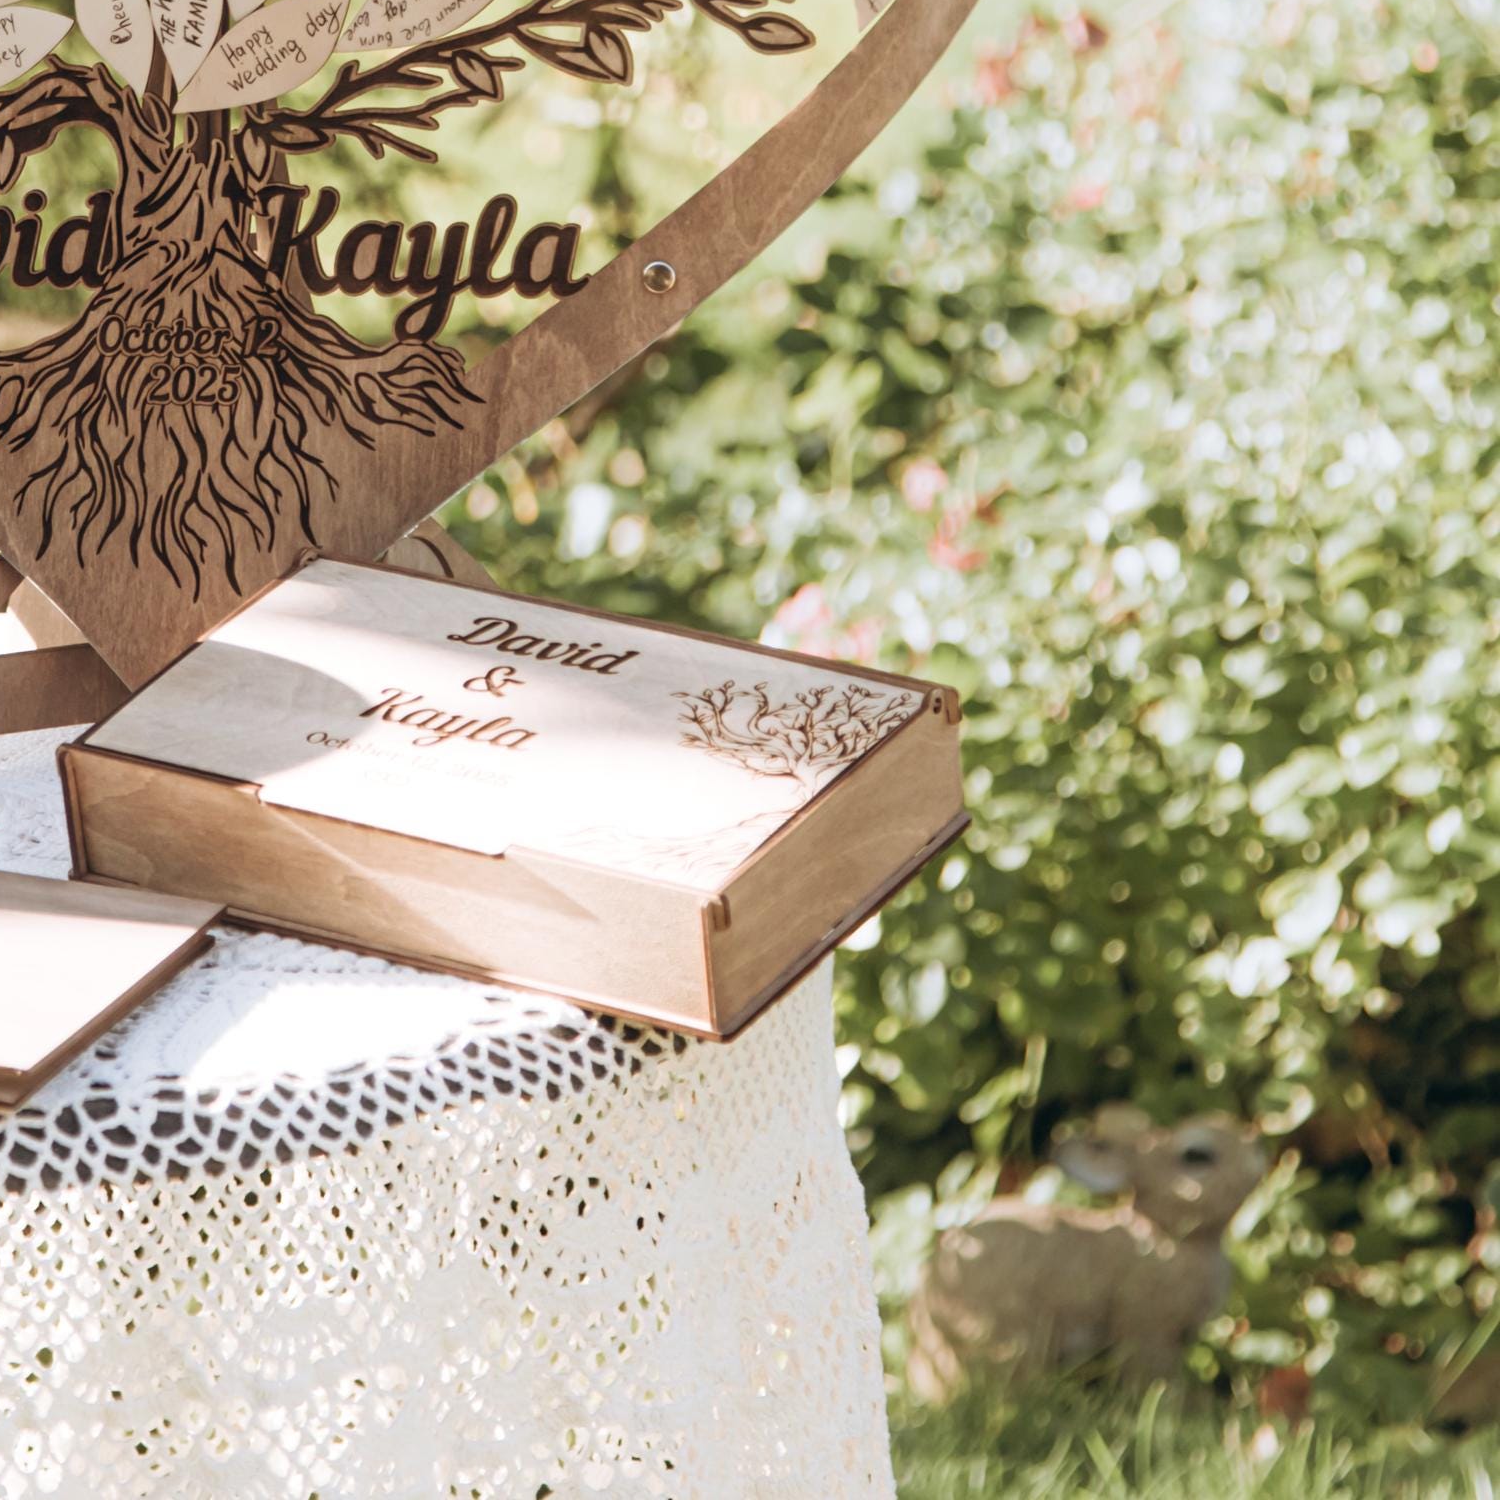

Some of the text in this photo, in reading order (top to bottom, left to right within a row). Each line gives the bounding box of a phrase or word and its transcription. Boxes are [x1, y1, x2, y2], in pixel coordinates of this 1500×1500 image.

[158, 13, 177, 45] THE
[220, 25, 274, 68] Happy
[227, 1, 342, 92] wedding day
[257, 184, 592, 342] Kayla
[98, 314, 234, 357] October
[148, 363, 242, 406] 2025
[447, 616, 641, 675] David
[462, 666, 526, 697] &
[359, 687, 538, 750] Kayla
